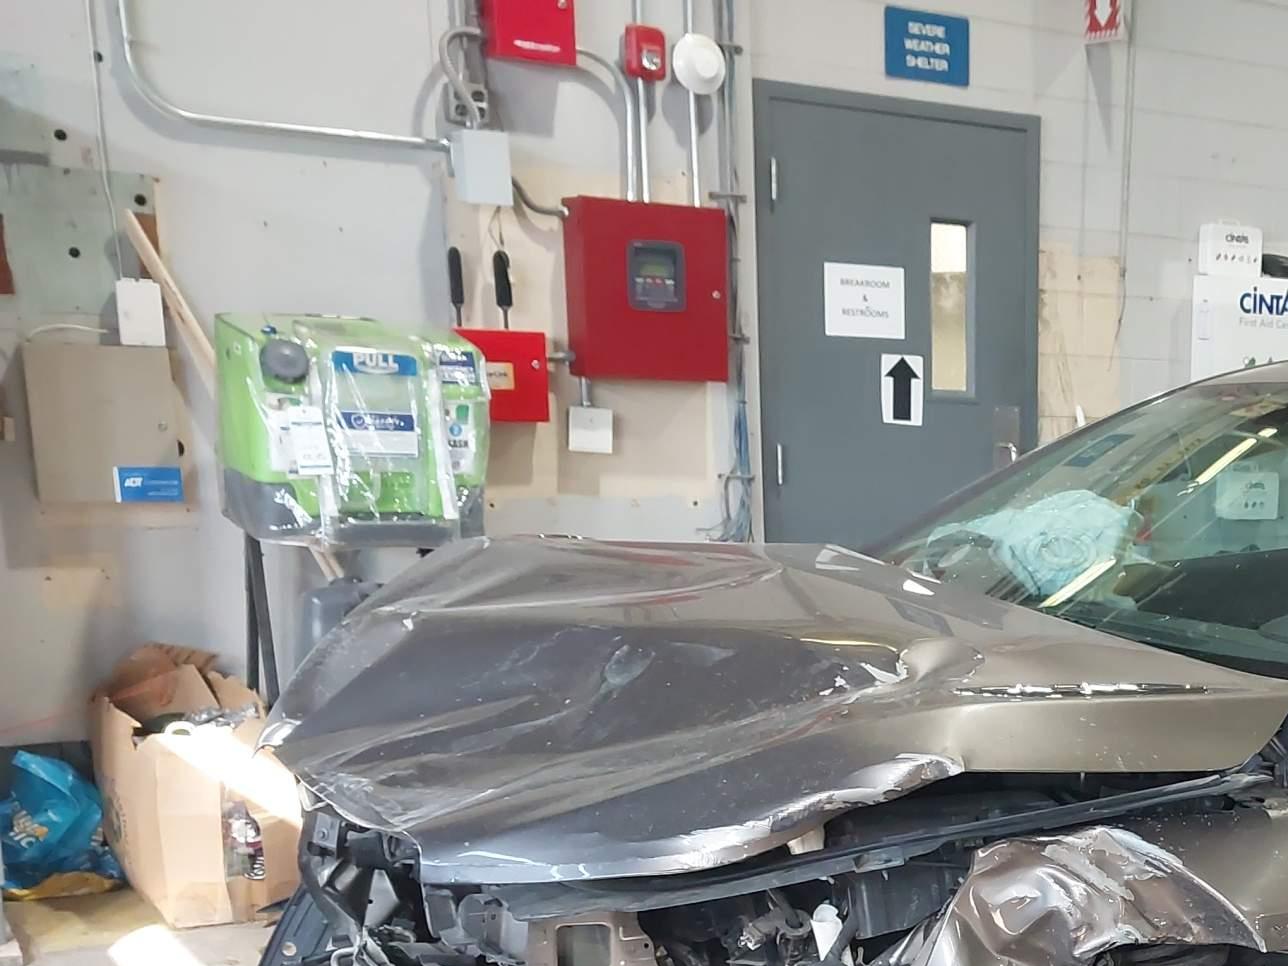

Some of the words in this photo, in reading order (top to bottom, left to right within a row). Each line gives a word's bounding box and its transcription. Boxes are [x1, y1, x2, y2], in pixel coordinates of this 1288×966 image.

[908, 21, 945, 38] SEVERE
[904, 38, 950, 56] WEATHER
[906, 54, 948, 72] SHELTER
[840, 278, 890, 288] BREAKROOM
[842, 307, 889, 319] RESTROOMS
[1240, 317, 1257, 327] First
[1260, 318, 1274, 328] Aid
[353, 351, 399, 369] PULL
